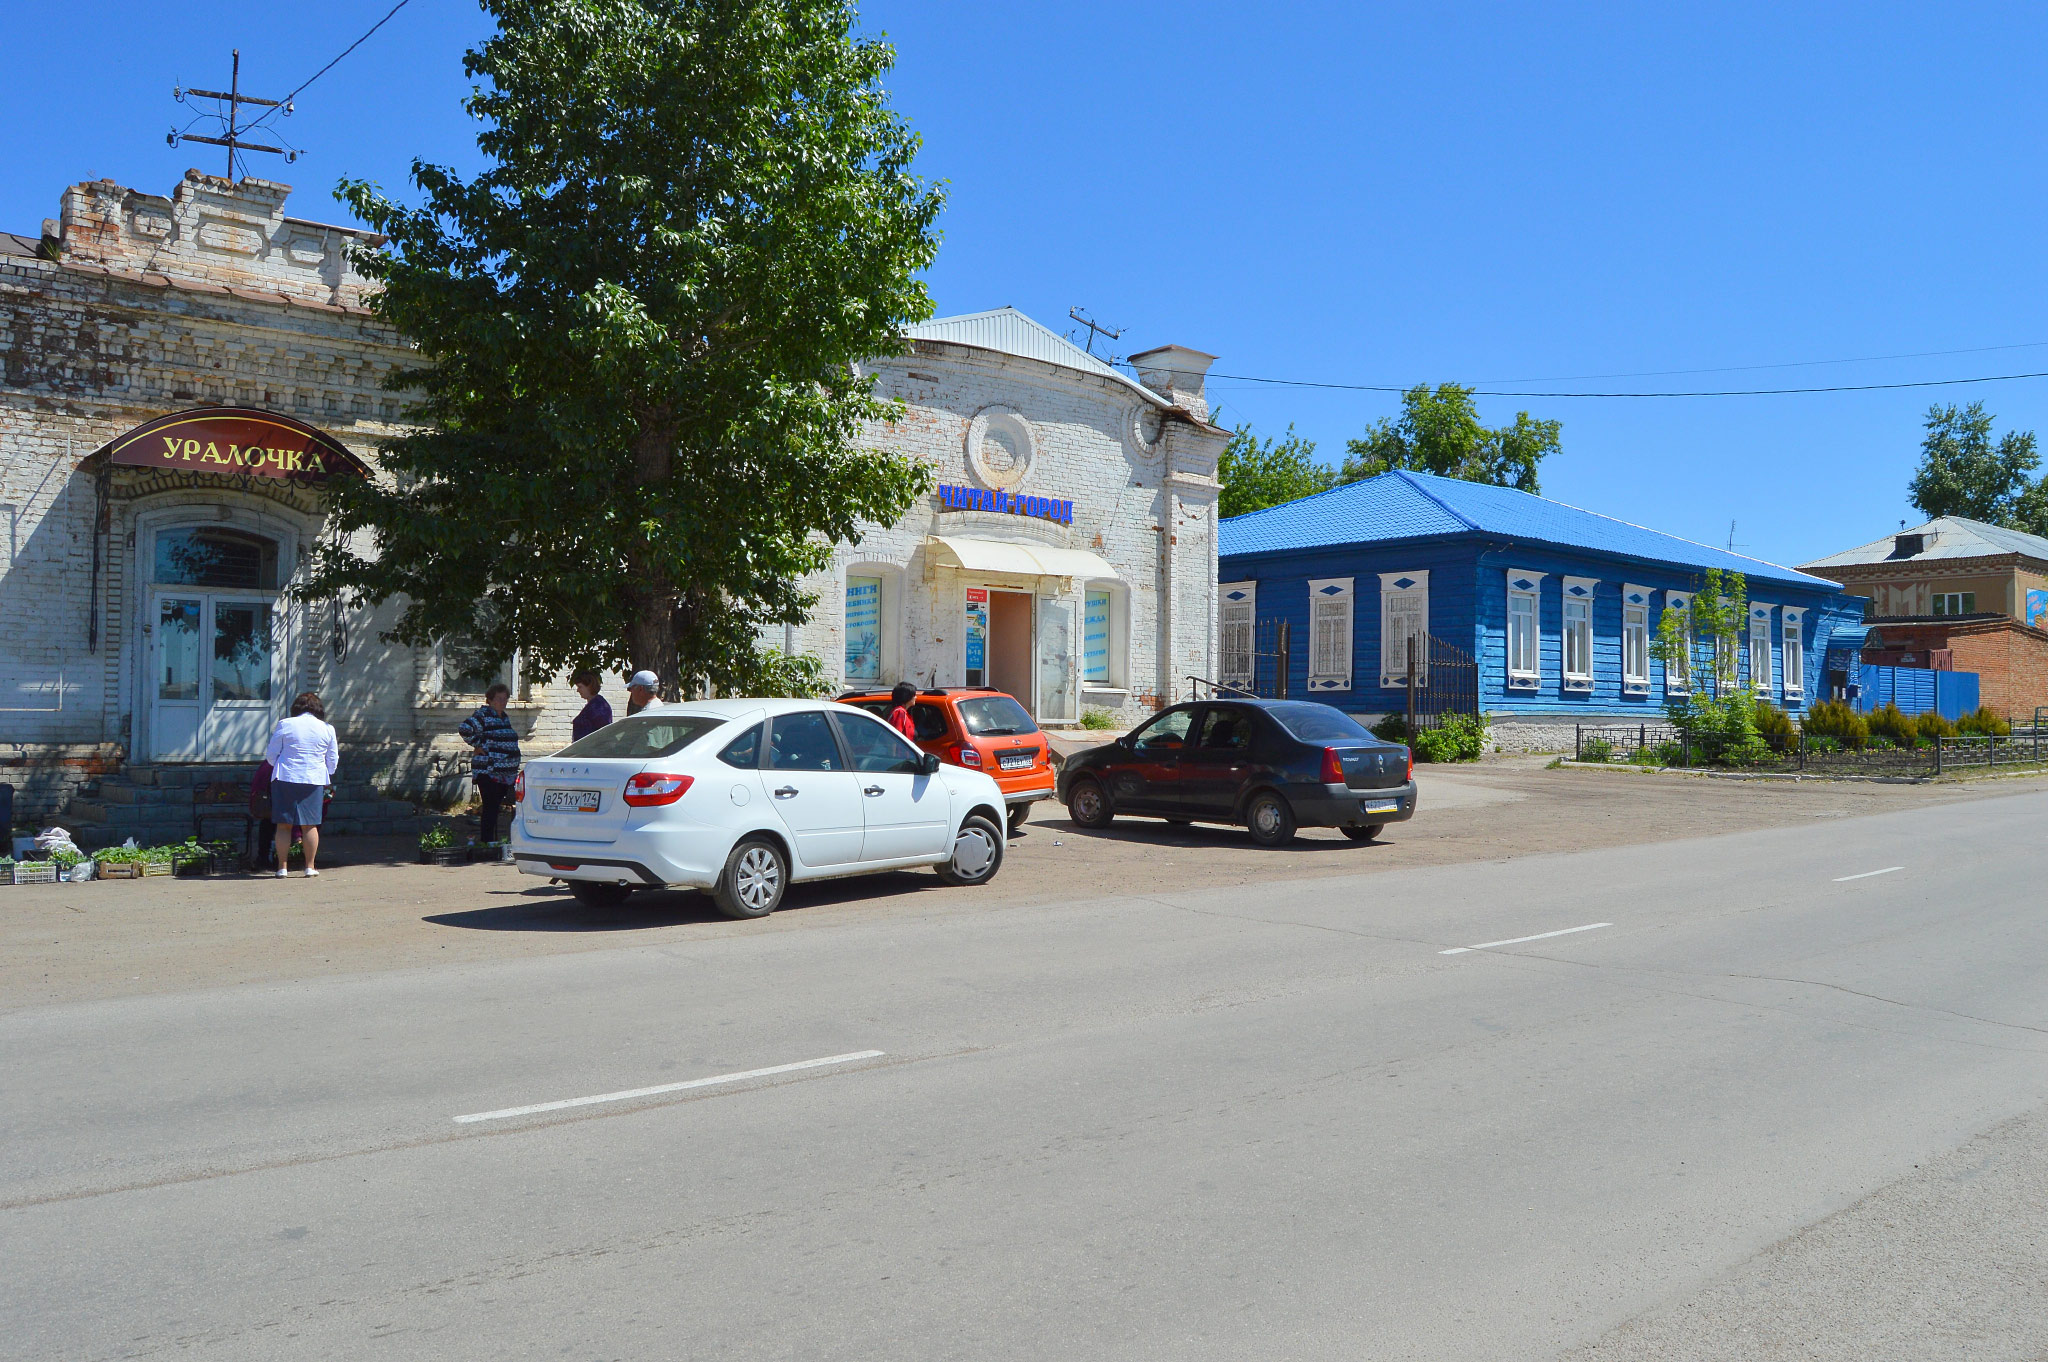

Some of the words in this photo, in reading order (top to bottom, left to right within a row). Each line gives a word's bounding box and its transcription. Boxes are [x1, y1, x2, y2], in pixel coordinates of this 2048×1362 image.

[163, 437, 327, 473] УРАЛОЧКА
[938, 485, 1073, 525] ЧИТАЙ-ГОРОД
[847, 584, 877, 597] НИГИ
[582, 792, 597, 803] 174
